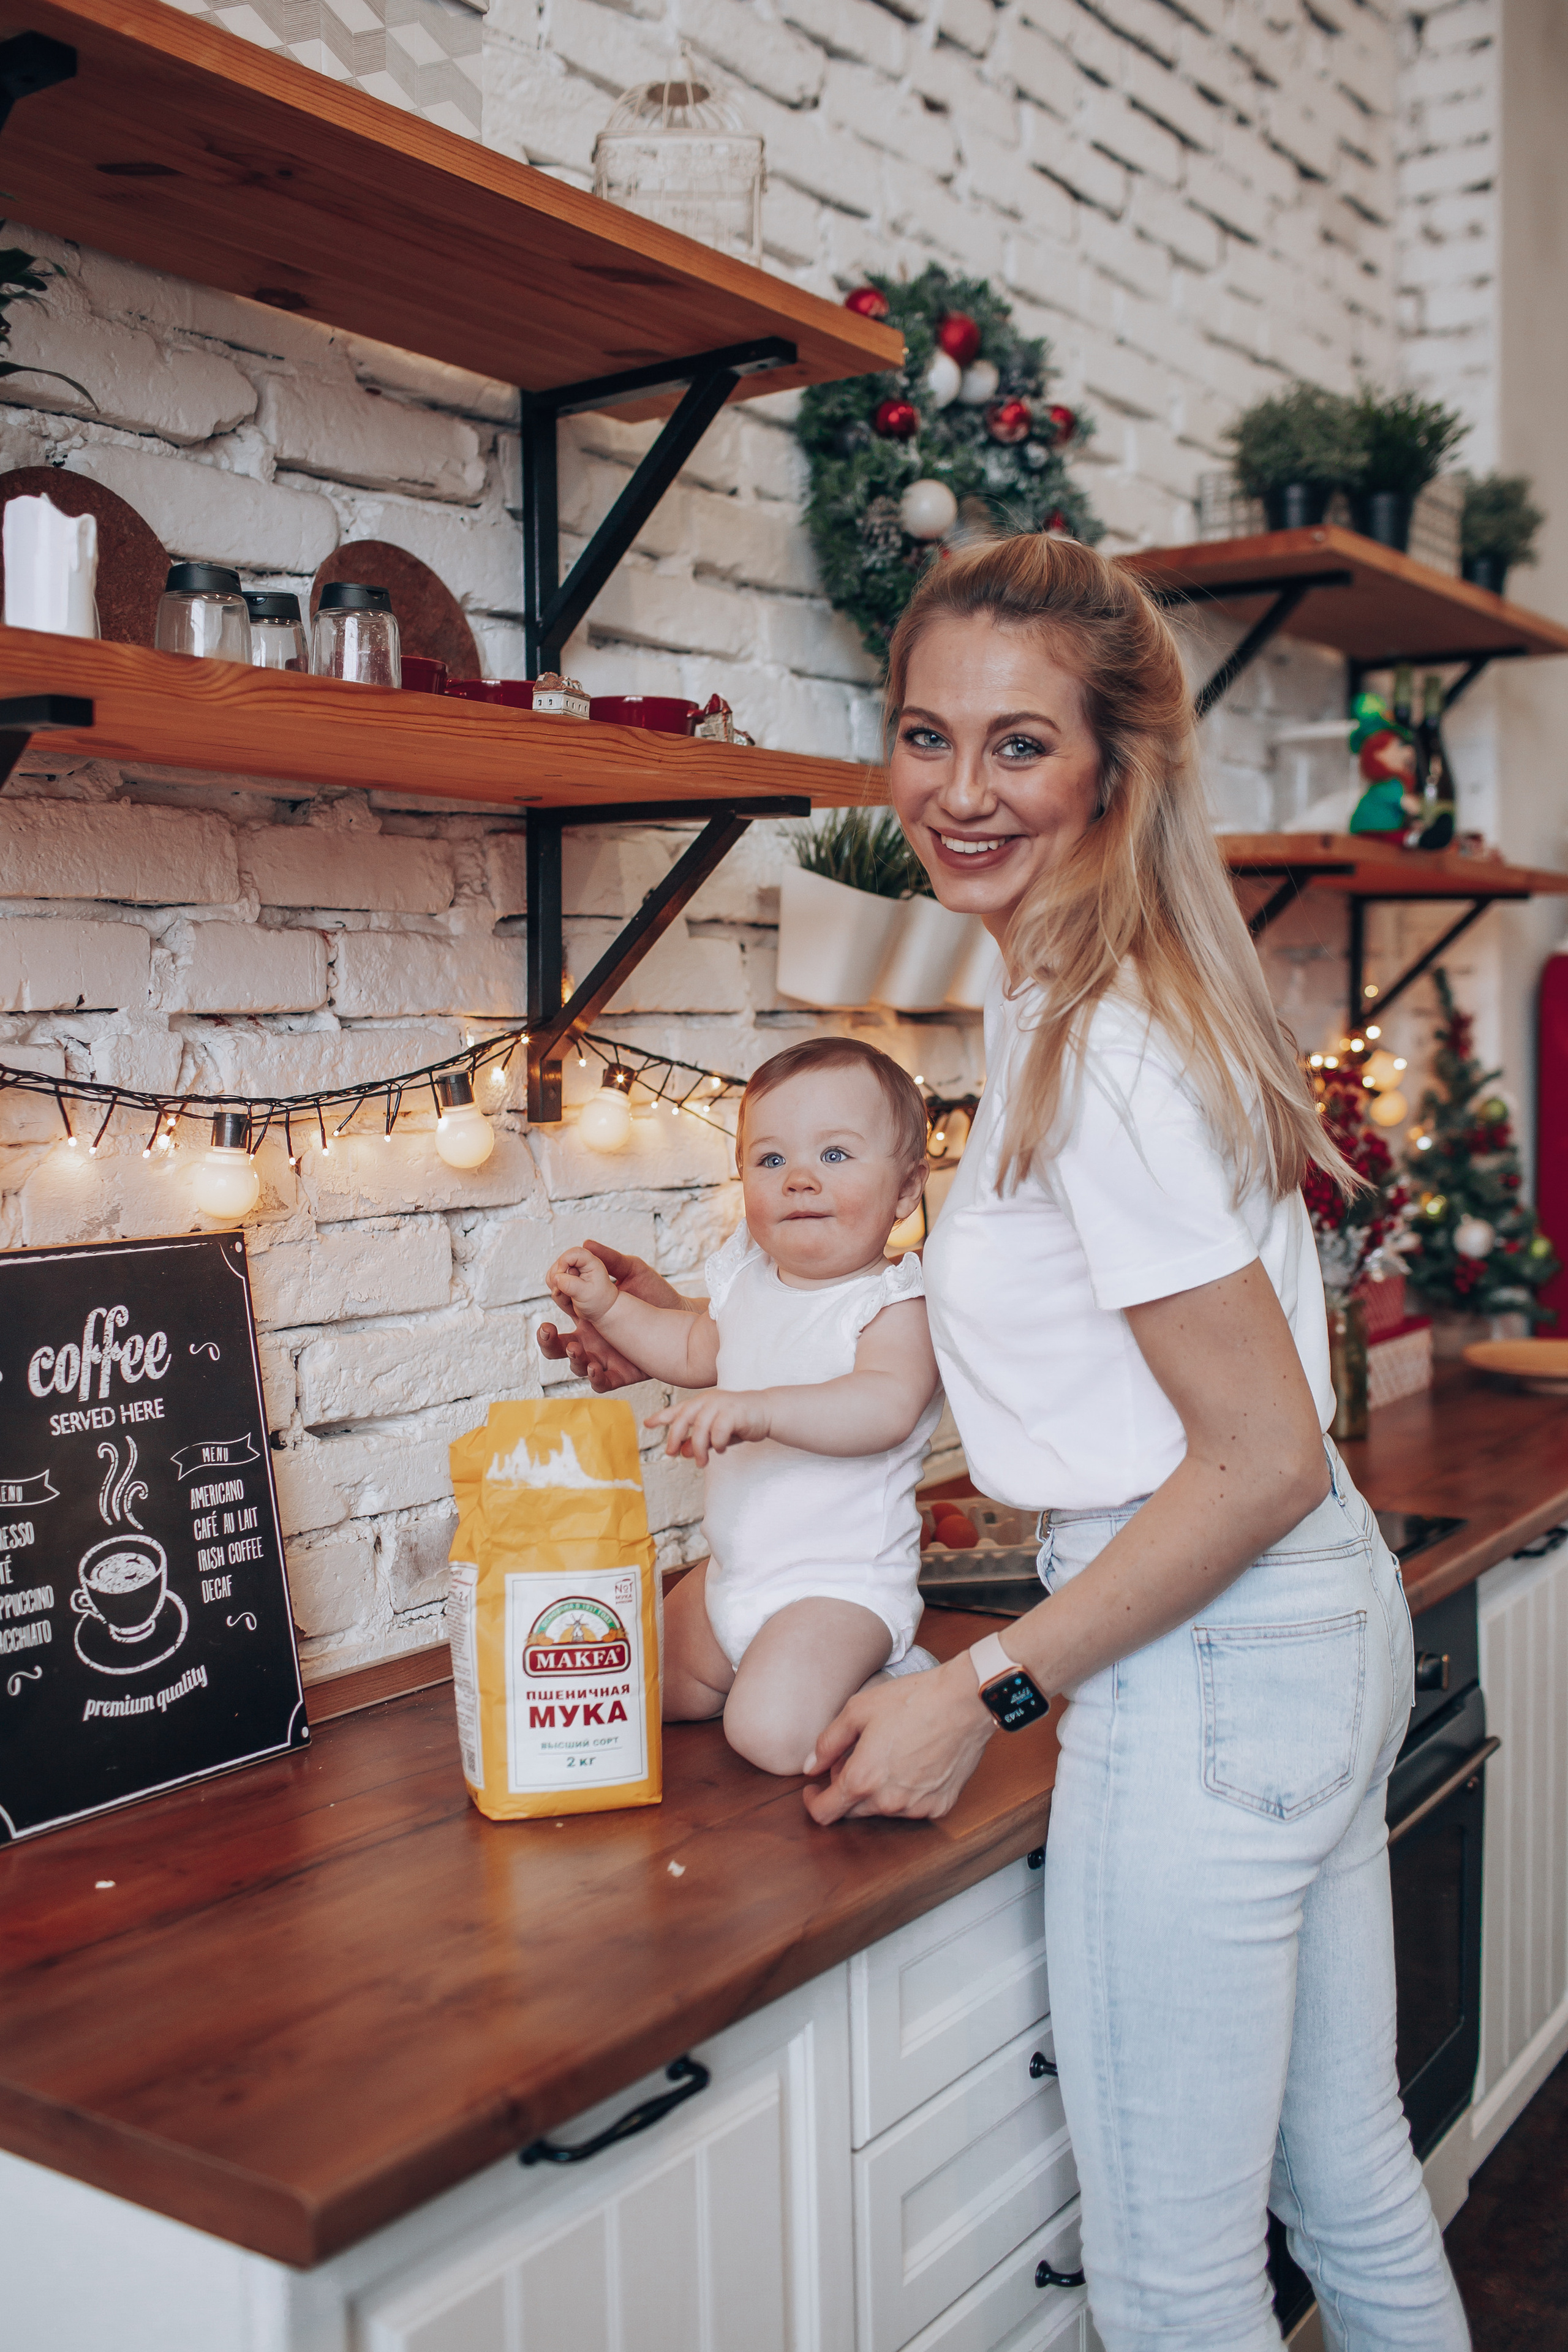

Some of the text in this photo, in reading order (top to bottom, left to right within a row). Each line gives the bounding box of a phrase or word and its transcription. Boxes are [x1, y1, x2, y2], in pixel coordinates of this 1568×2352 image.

[28, 1305, 172, 1402] coffee
[50, 1398, 165, 1436] SERVED HERE
[202, 1447, 228, 1463] MENU
[0, 1485, 23, 1502] ENU
[190, 1479, 244, 1510] AMERICANO
[194, 1507, 257, 1540] CAFÉ AU LAIT
[197, 1536, 264, 1572] IRISH COFFEE
[202, 1575, 232, 1604] DECAF
[536, 1649, 620, 1669] MAKFA
[83, 1665, 208, 1722] premium quality
[526, 1684, 630, 1700] ПШЕНИЧНАЯ
[529, 1700, 628, 1728] МУКА
[541, 1736, 619, 1750] ВЫСШИЙ СОРТ
[567, 1757, 576, 1767] 2
